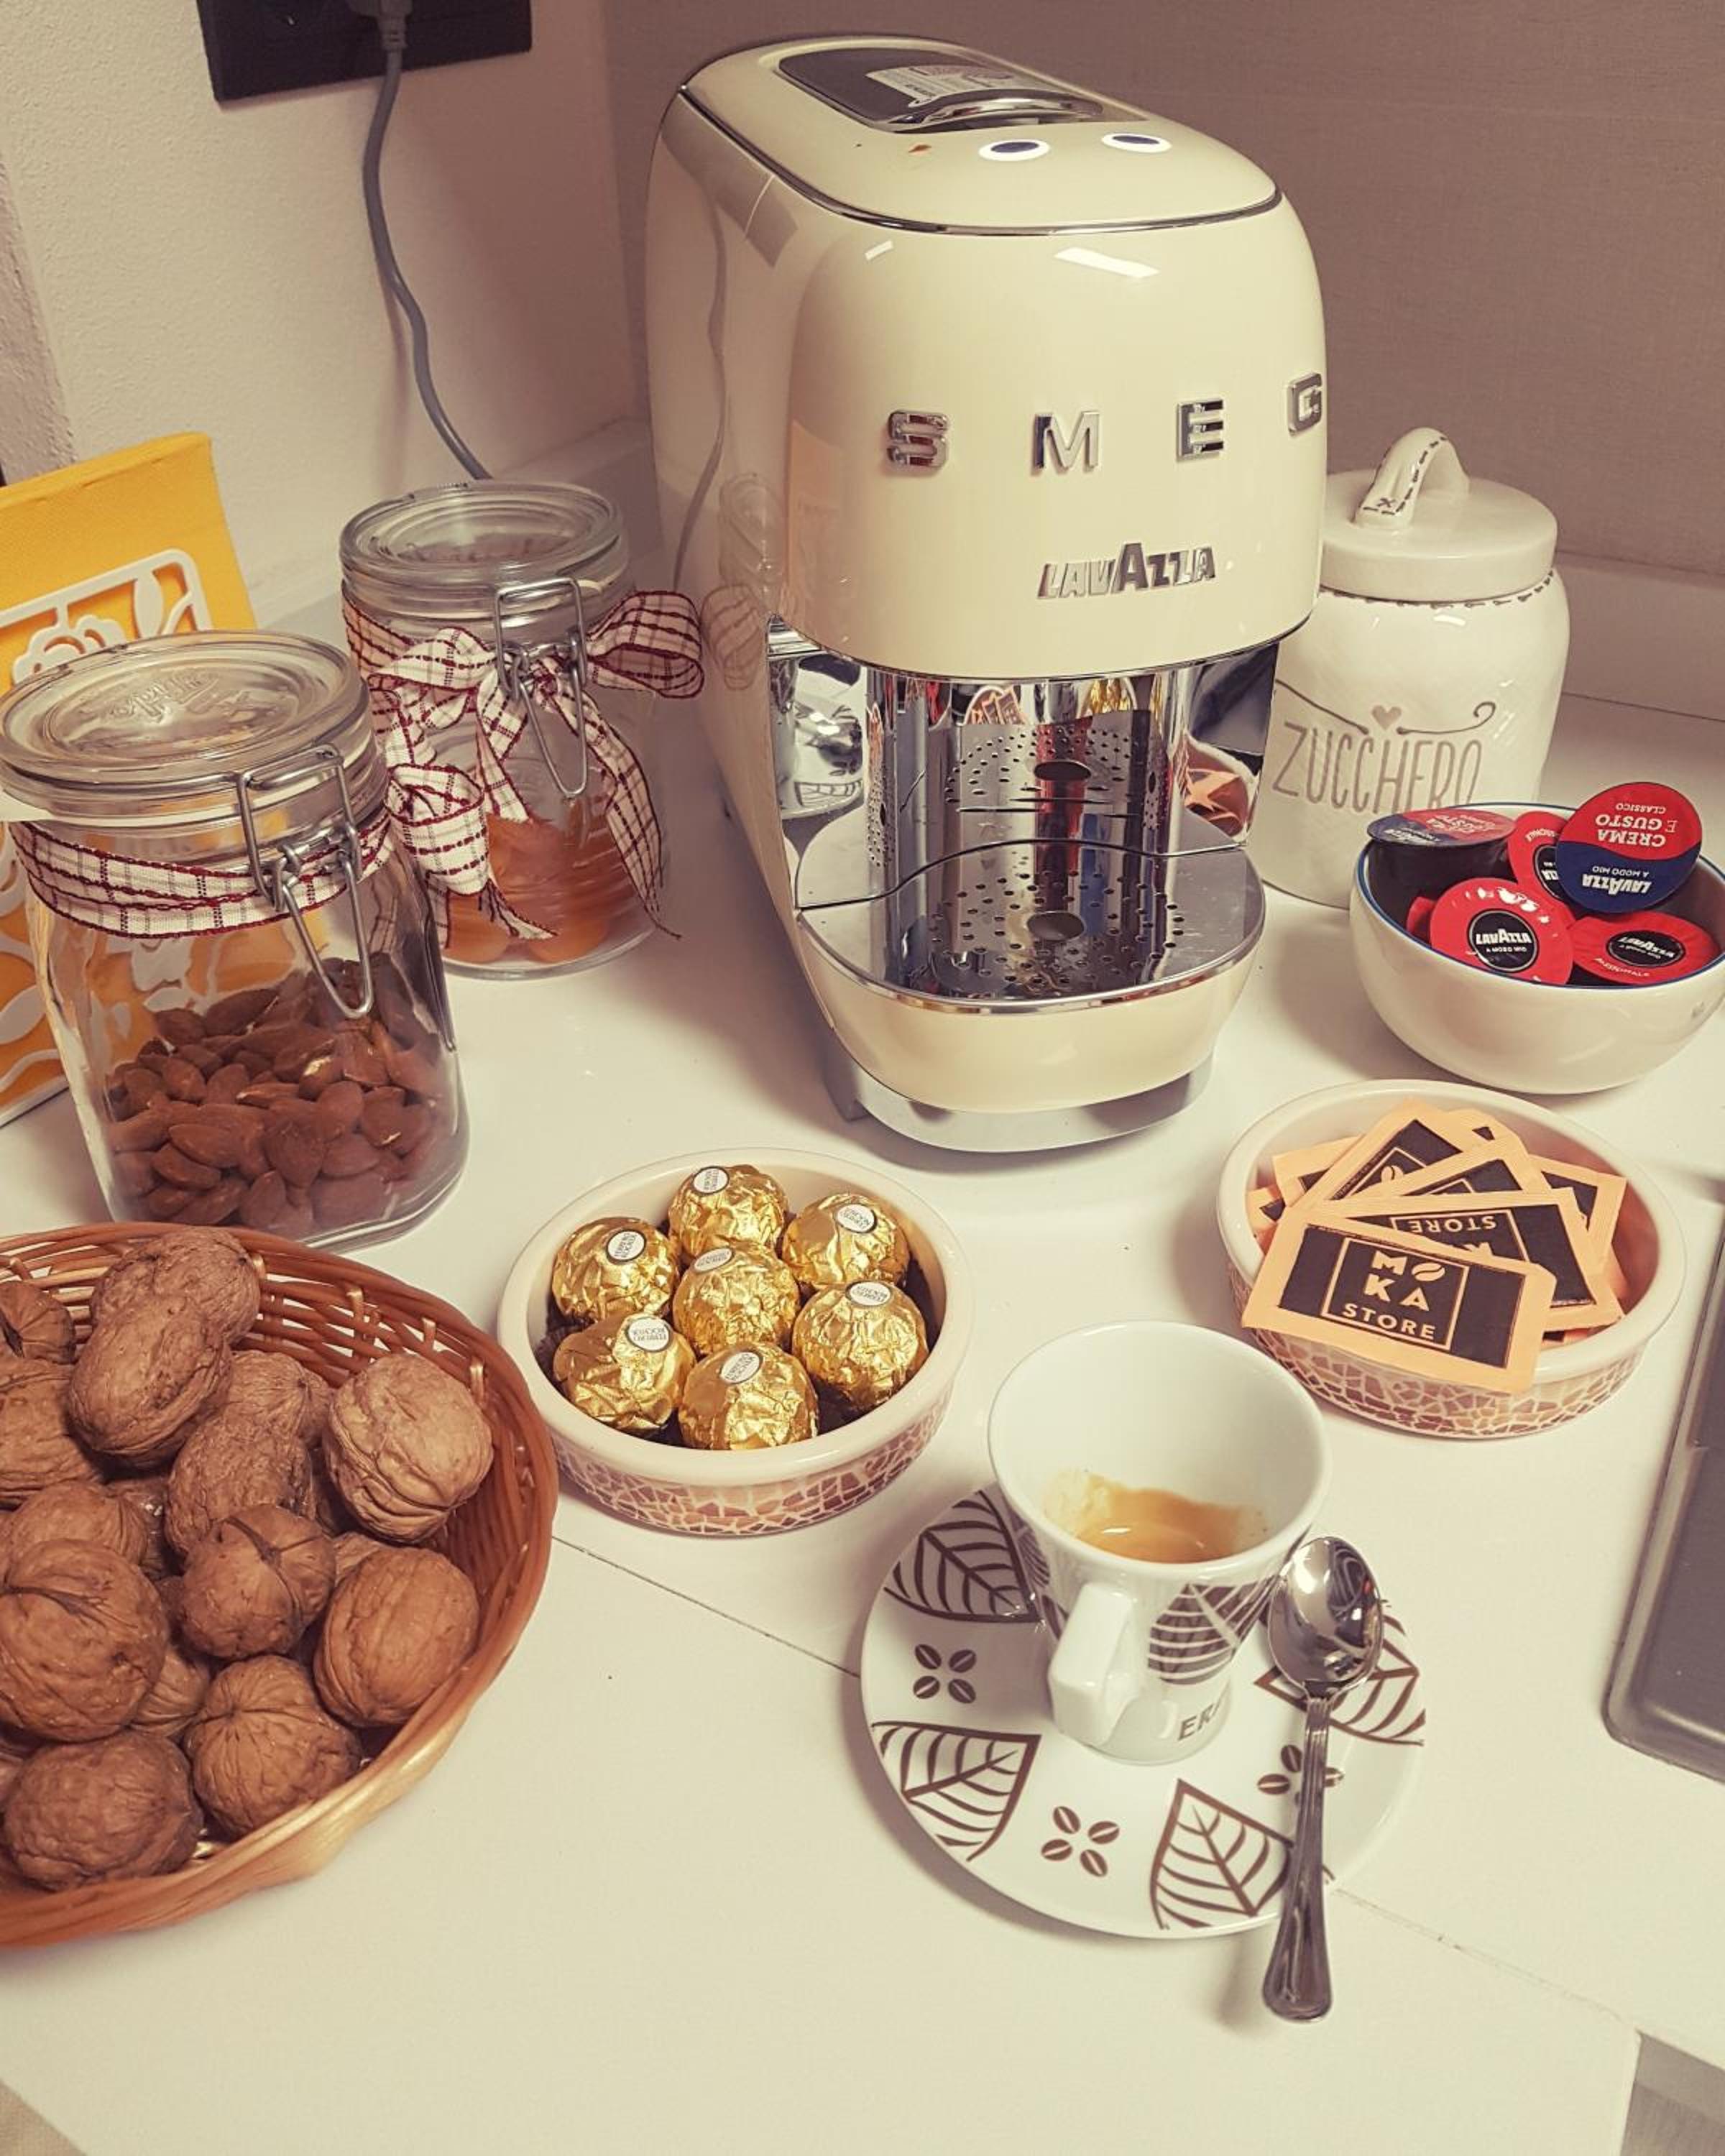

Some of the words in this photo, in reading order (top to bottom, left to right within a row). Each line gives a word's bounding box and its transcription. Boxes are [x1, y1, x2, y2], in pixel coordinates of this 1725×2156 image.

[886, 372, 1322, 470] SMEG
[1037, 542, 1216, 599] LAVAZZA
[1271, 721, 1482, 814] ZUCCHERO
[1615, 803, 1667, 814] CLASSICO
[1595, 814, 1662, 831] GUSTO
[1665, 820, 1678, 833] E
[1598, 829, 1666, 847] CREMA
[1592, 865, 1611, 875] MIO
[1611, 867, 1640, 877] MODO
[1582, 873, 1652, 895] LAVAZZA
[1476, 928, 1532, 945] LAVAZZA
[1407, 1216, 1497, 1233] STORE
[1342, 1302, 1436, 1340] STORE
